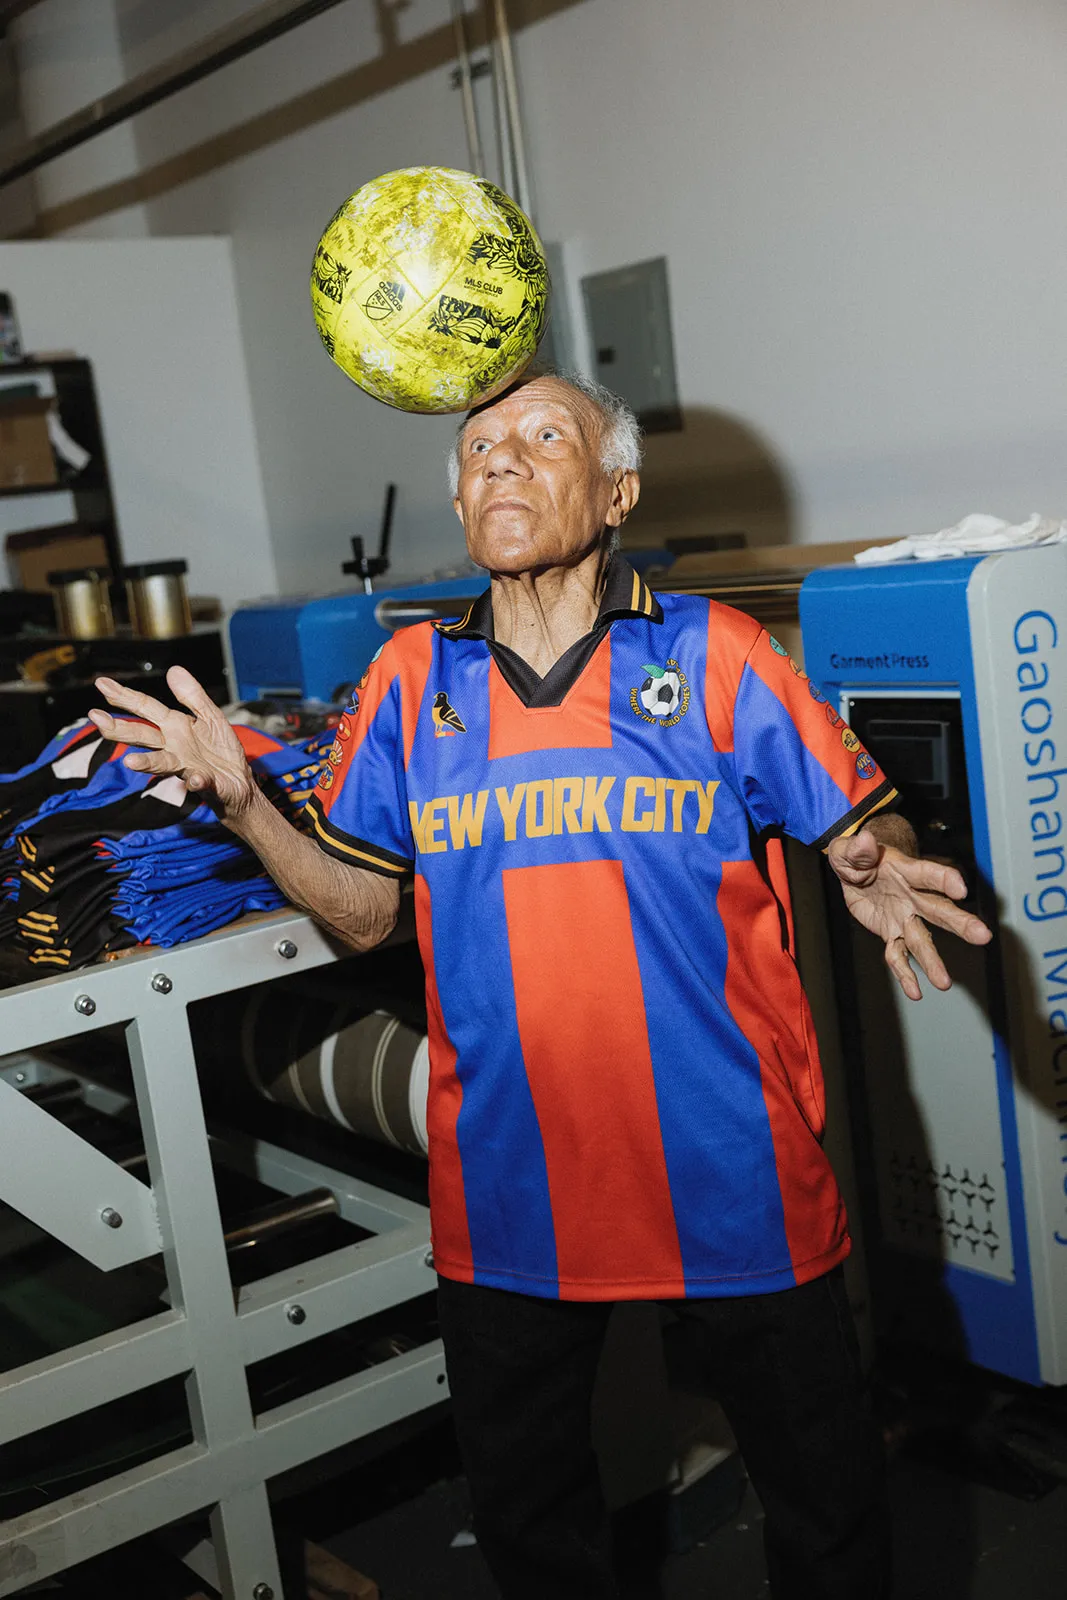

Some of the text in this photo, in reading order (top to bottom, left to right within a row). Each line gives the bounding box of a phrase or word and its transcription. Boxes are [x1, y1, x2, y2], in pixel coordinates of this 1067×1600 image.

[379, 281, 402, 311] adidas
[465, 277, 503, 294] MLS CLUB
[374, 292, 385, 306] MLS
[830, 653, 929, 669] Garment Press
[630, 687, 642, 716] WHERE
[641, 714, 657, 724] THE
[659, 715, 680, 728] WORLD
[679, 686, 690, 716] COMES
[857, 754, 871, 771] NYC
[1013, 609, 1067, 923] Gaoshang
[495, 776, 616, 842] YORK
[620, 776, 721, 835] CITY
